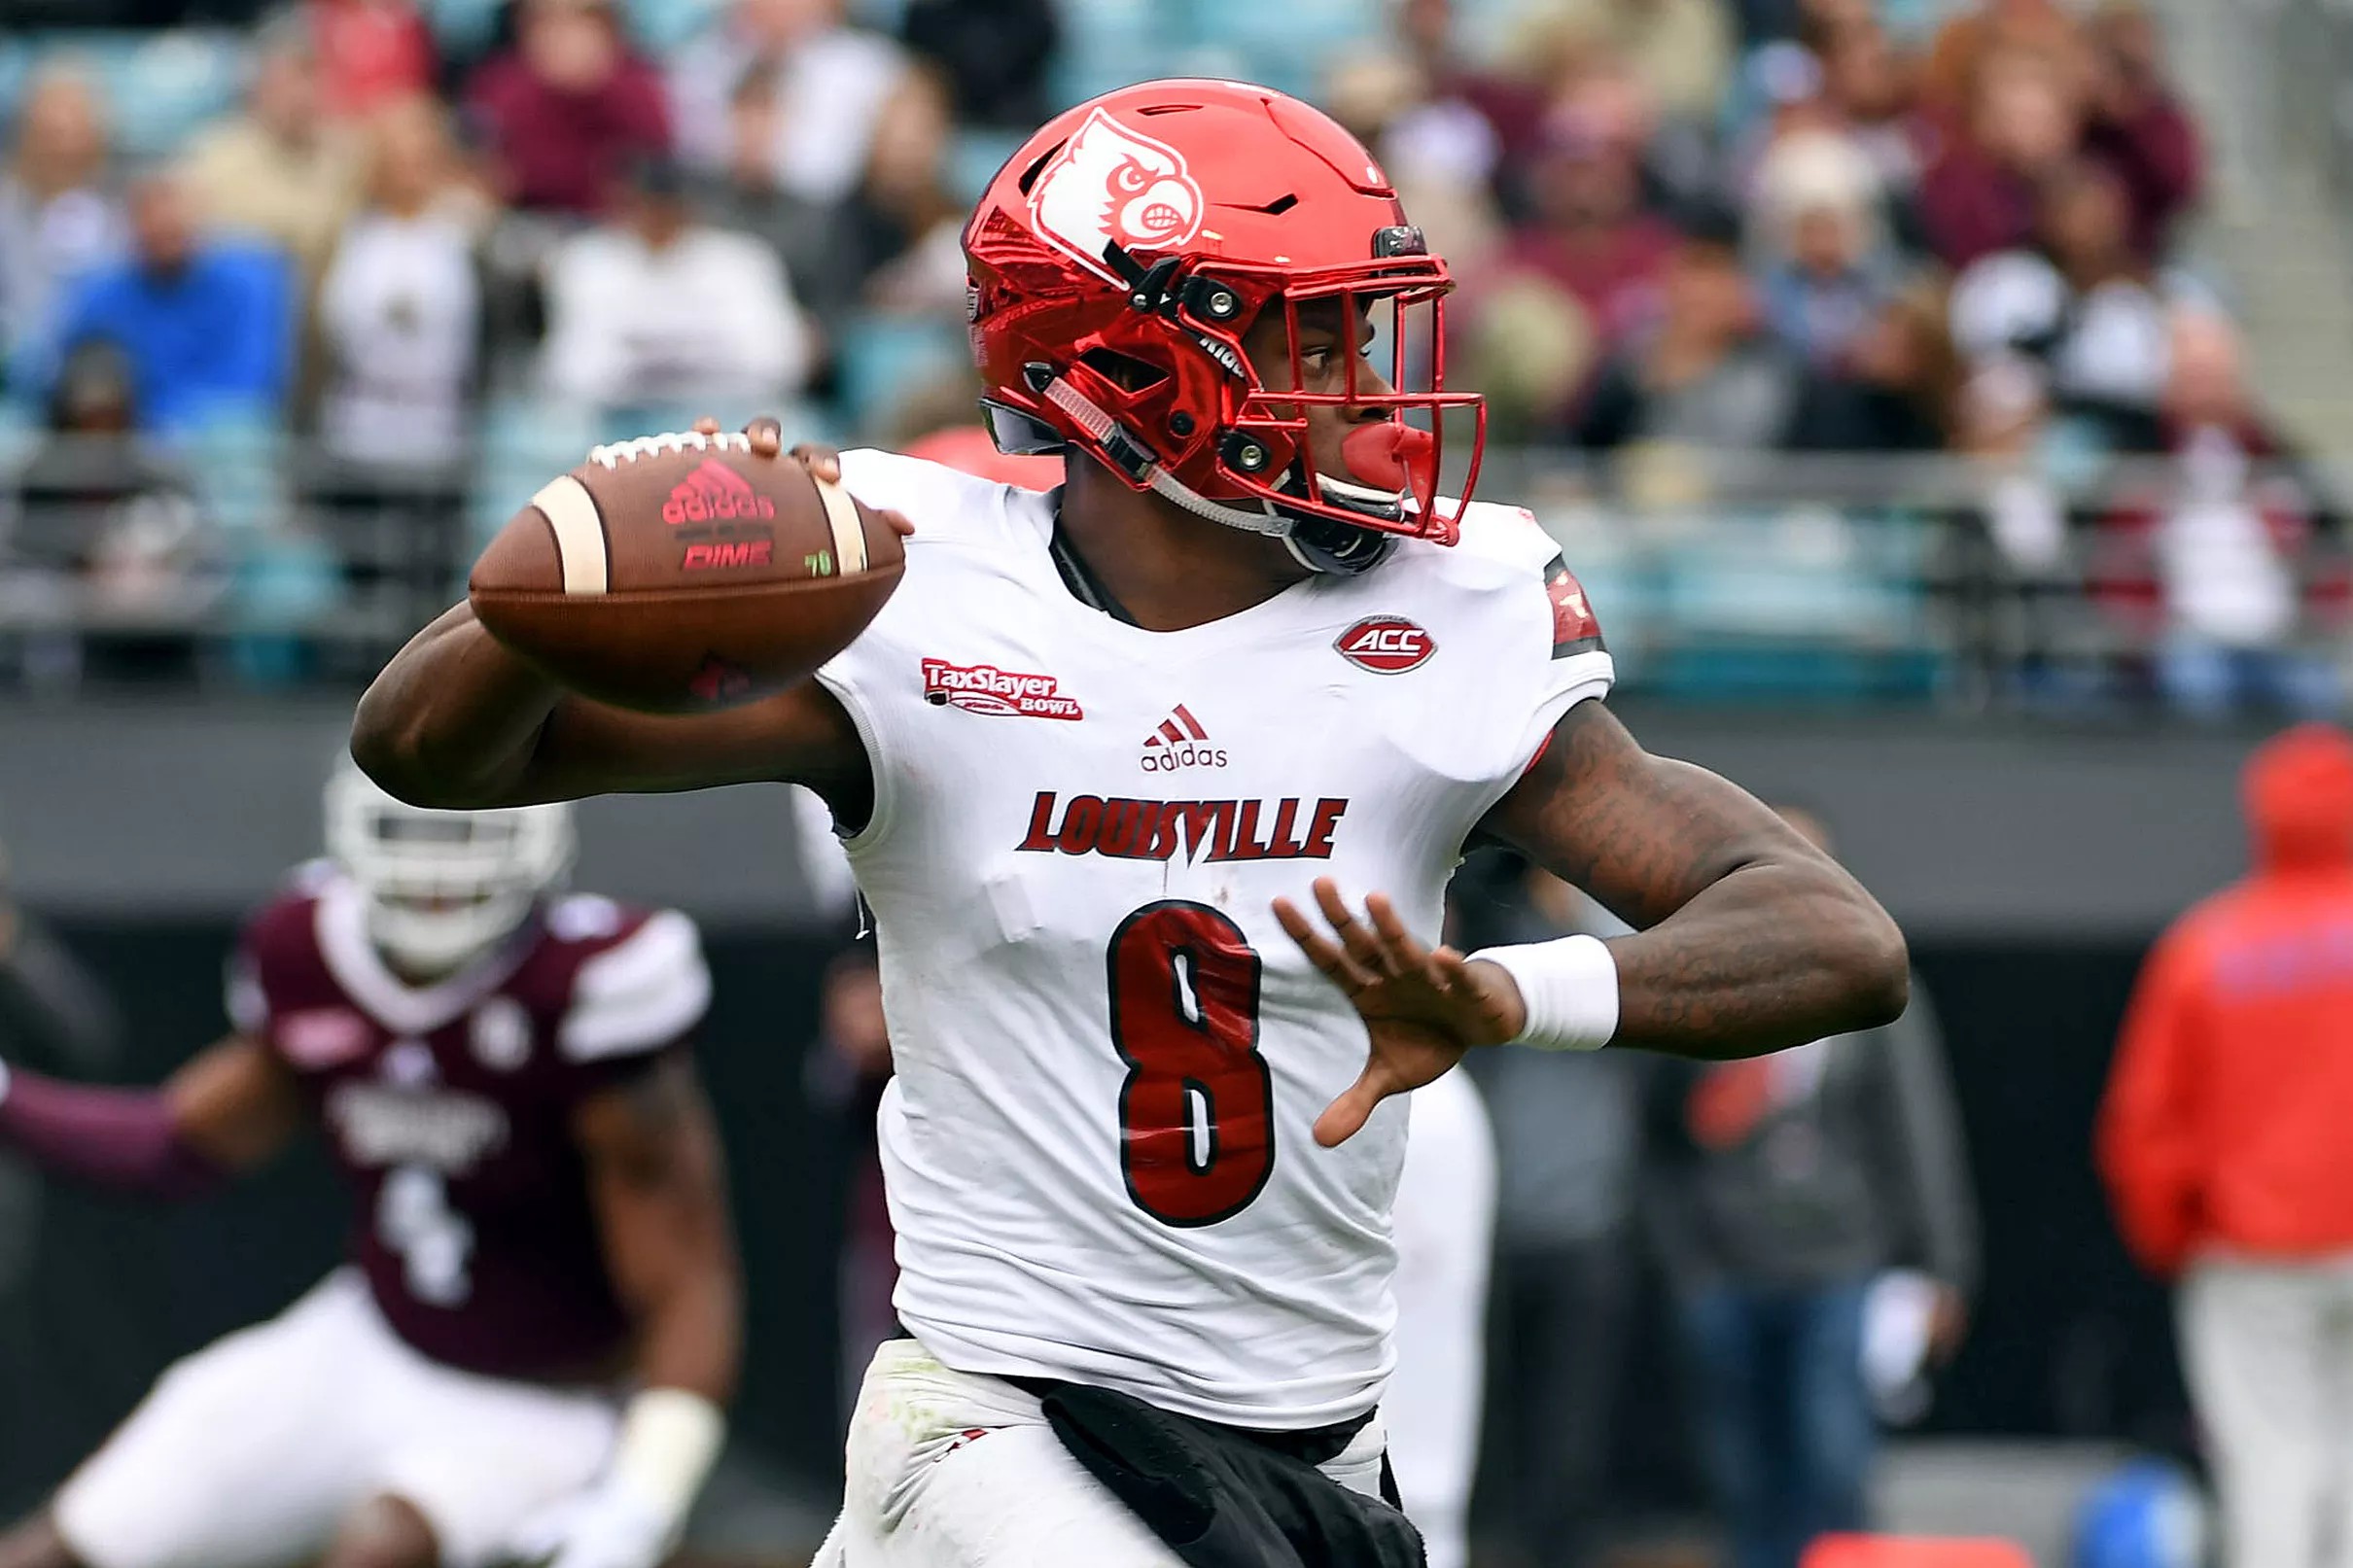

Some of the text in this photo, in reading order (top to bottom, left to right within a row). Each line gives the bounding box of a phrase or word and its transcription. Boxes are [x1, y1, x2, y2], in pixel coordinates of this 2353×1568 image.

[684, 540, 772, 570] DIME
[1348, 629, 1425, 651] ACC
[924, 664, 1056, 699] TaxSlayer
[1021, 697, 1079, 714] BOWL
[1141, 742, 1227, 772] adidas
[1014, 791, 1350, 868] LOUISVILLE
[1106, 899, 1276, 1229] 8
